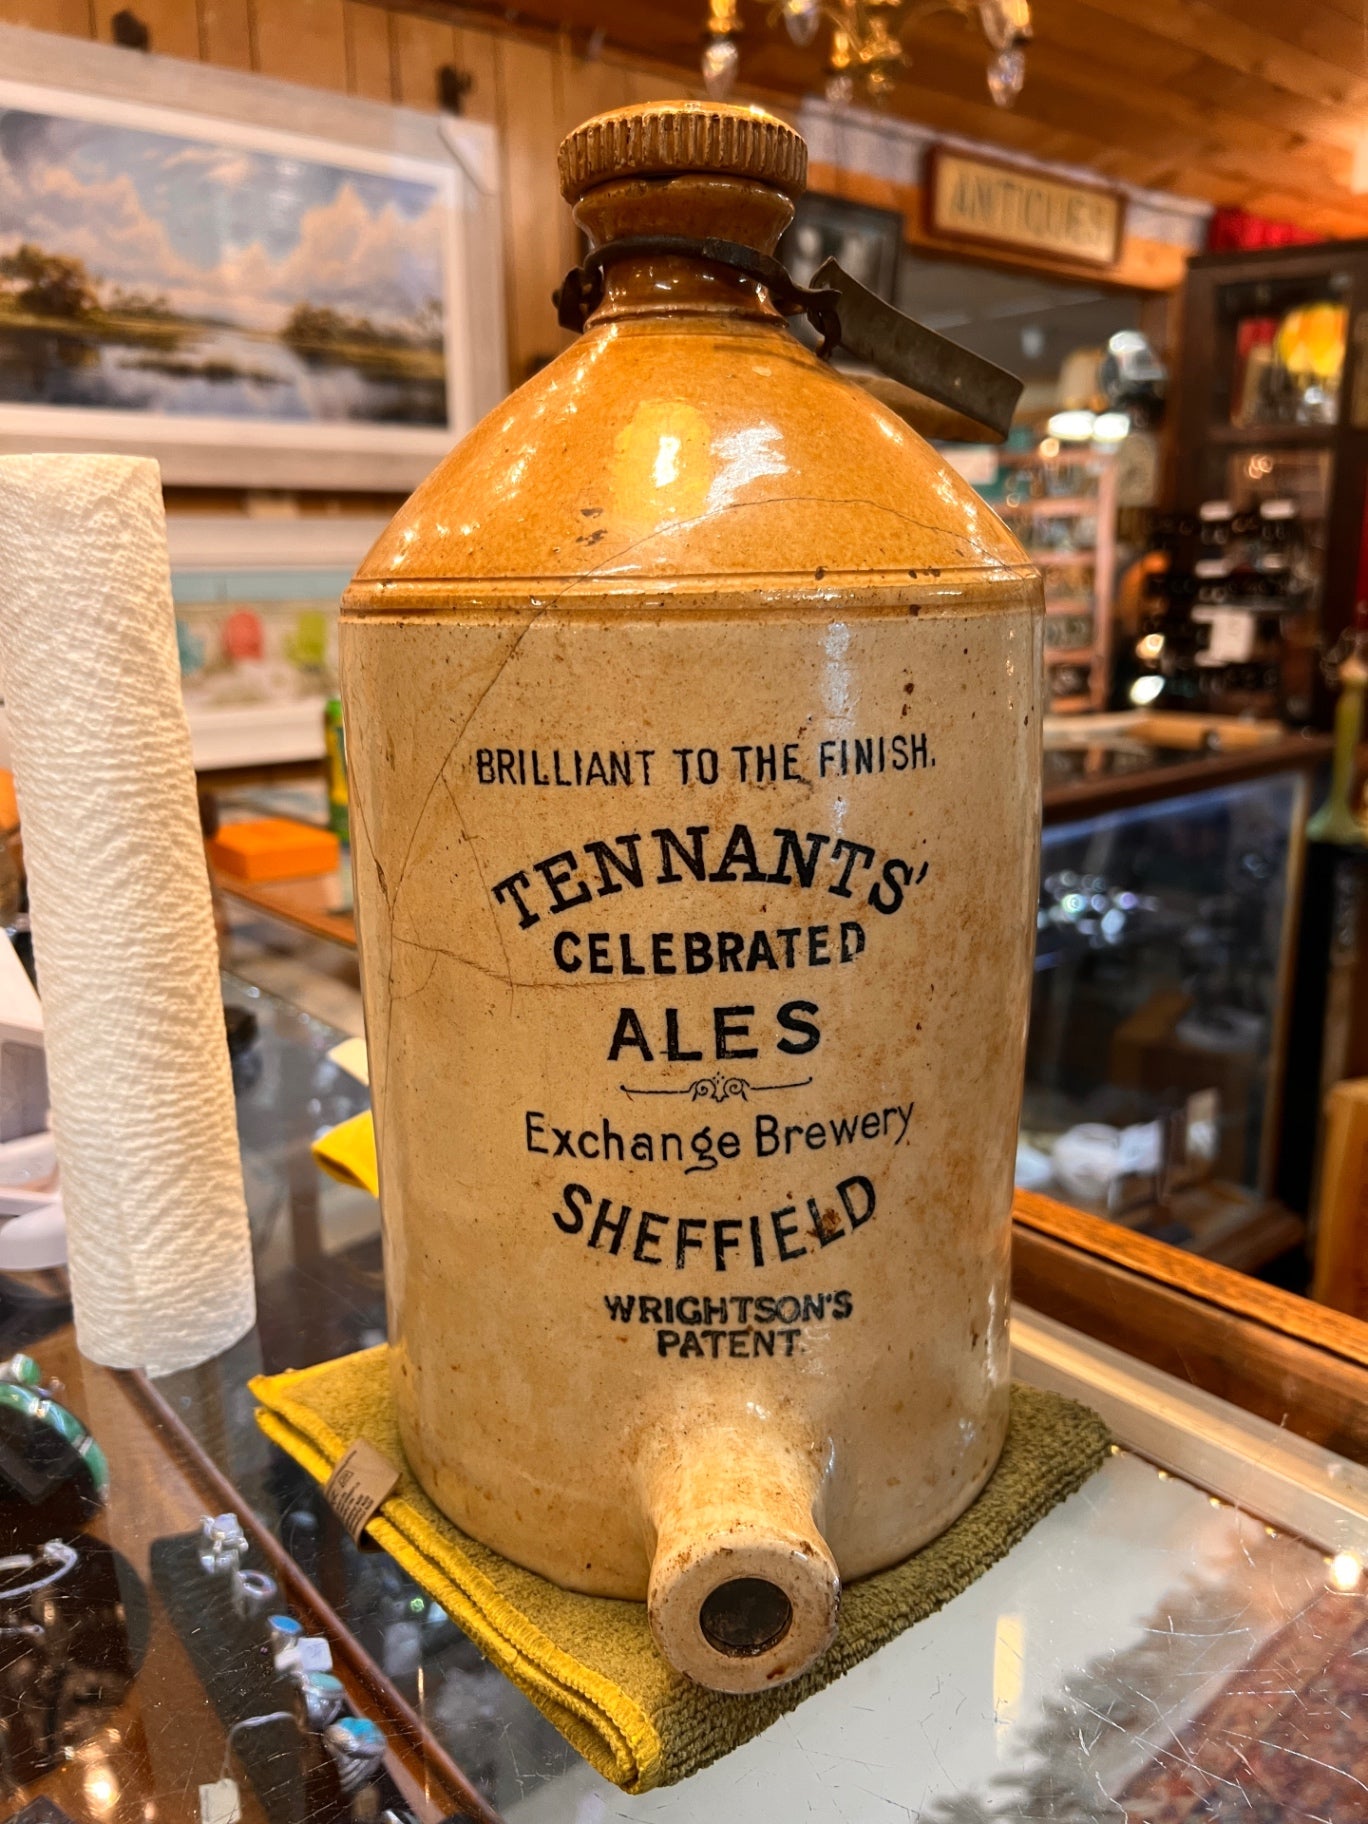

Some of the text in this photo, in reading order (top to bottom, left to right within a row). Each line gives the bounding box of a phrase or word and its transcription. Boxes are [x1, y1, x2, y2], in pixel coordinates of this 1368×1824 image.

[477, 733, 936, 786] BRILLIANT TO THE FINISH.
[553, 921, 866, 975] CELEBRATED
[607, 1000, 821, 1061] ALES
[526, 1102, 915, 1174] Exchange Brewery
[552, 1175, 877, 1272] SHEFFIELD
[604, 1290, 854, 1325] WRIGHTSON'S
